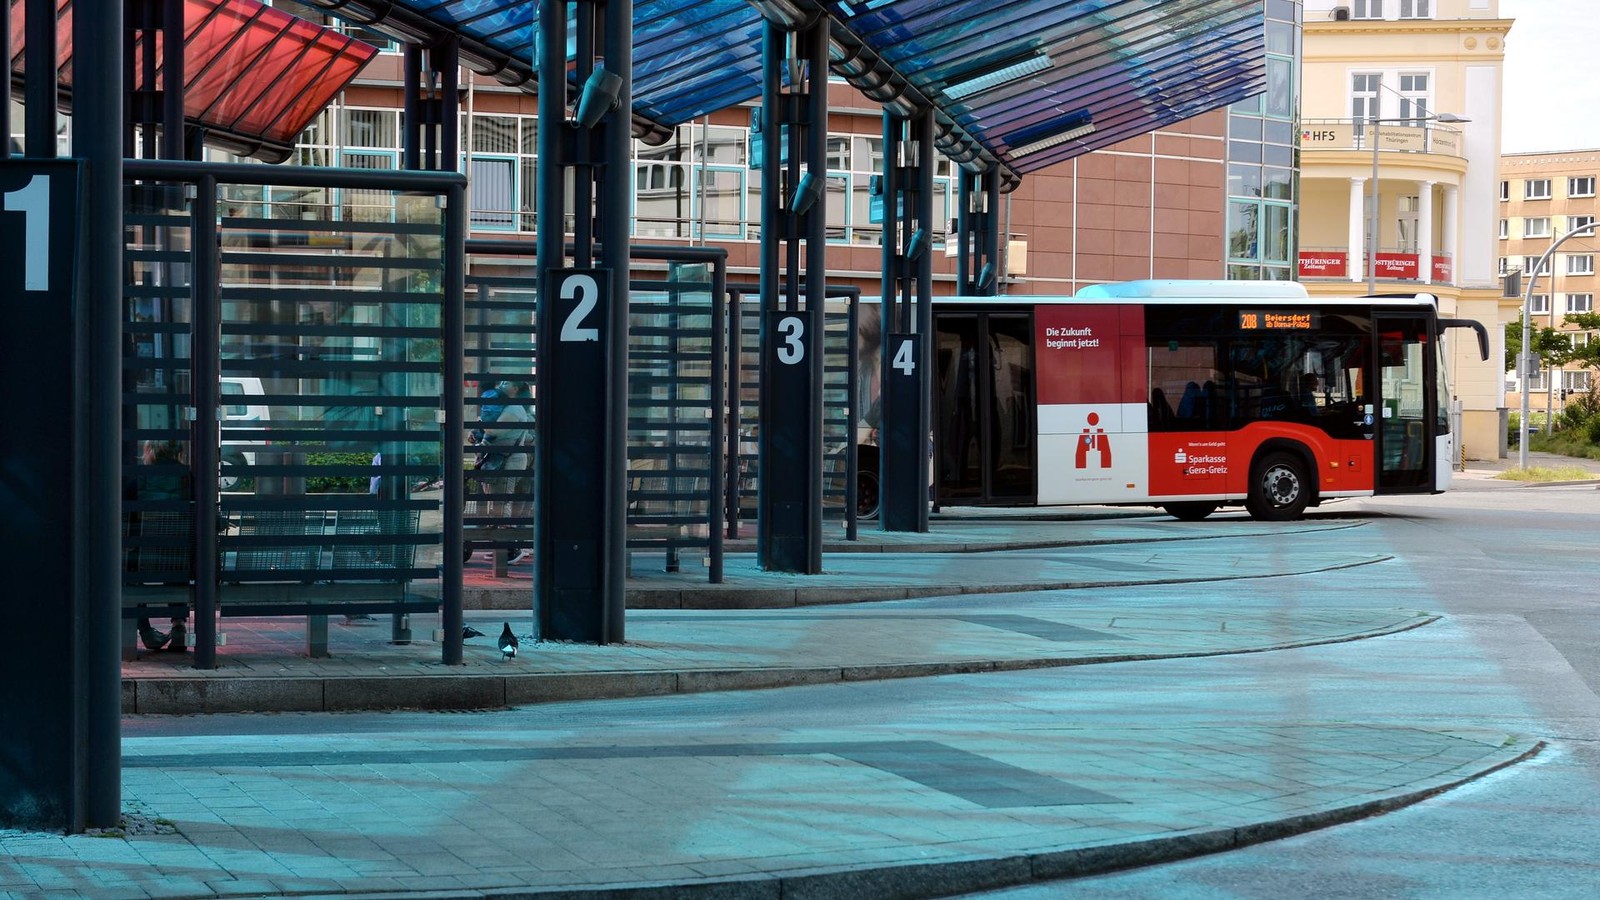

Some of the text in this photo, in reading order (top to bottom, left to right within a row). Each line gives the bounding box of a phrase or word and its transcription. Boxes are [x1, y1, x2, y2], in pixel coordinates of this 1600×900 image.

[1313, 131, 1335, 141] HFS
[4, 174, 49, 291] 1
[560, 274, 598, 342] 2
[1241, 314, 1257, 329] 208
[1046, 327, 1092, 336] Die Zukunft
[777, 317, 805, 365] 3
[1047, 339, 1099, 349] beginnt jetzt!
[893, 340, 916, 376] 4
[1189, 455, 1226, 465] Sparkasse
[1189, 465, 1228, 474] Gera-Greiz
